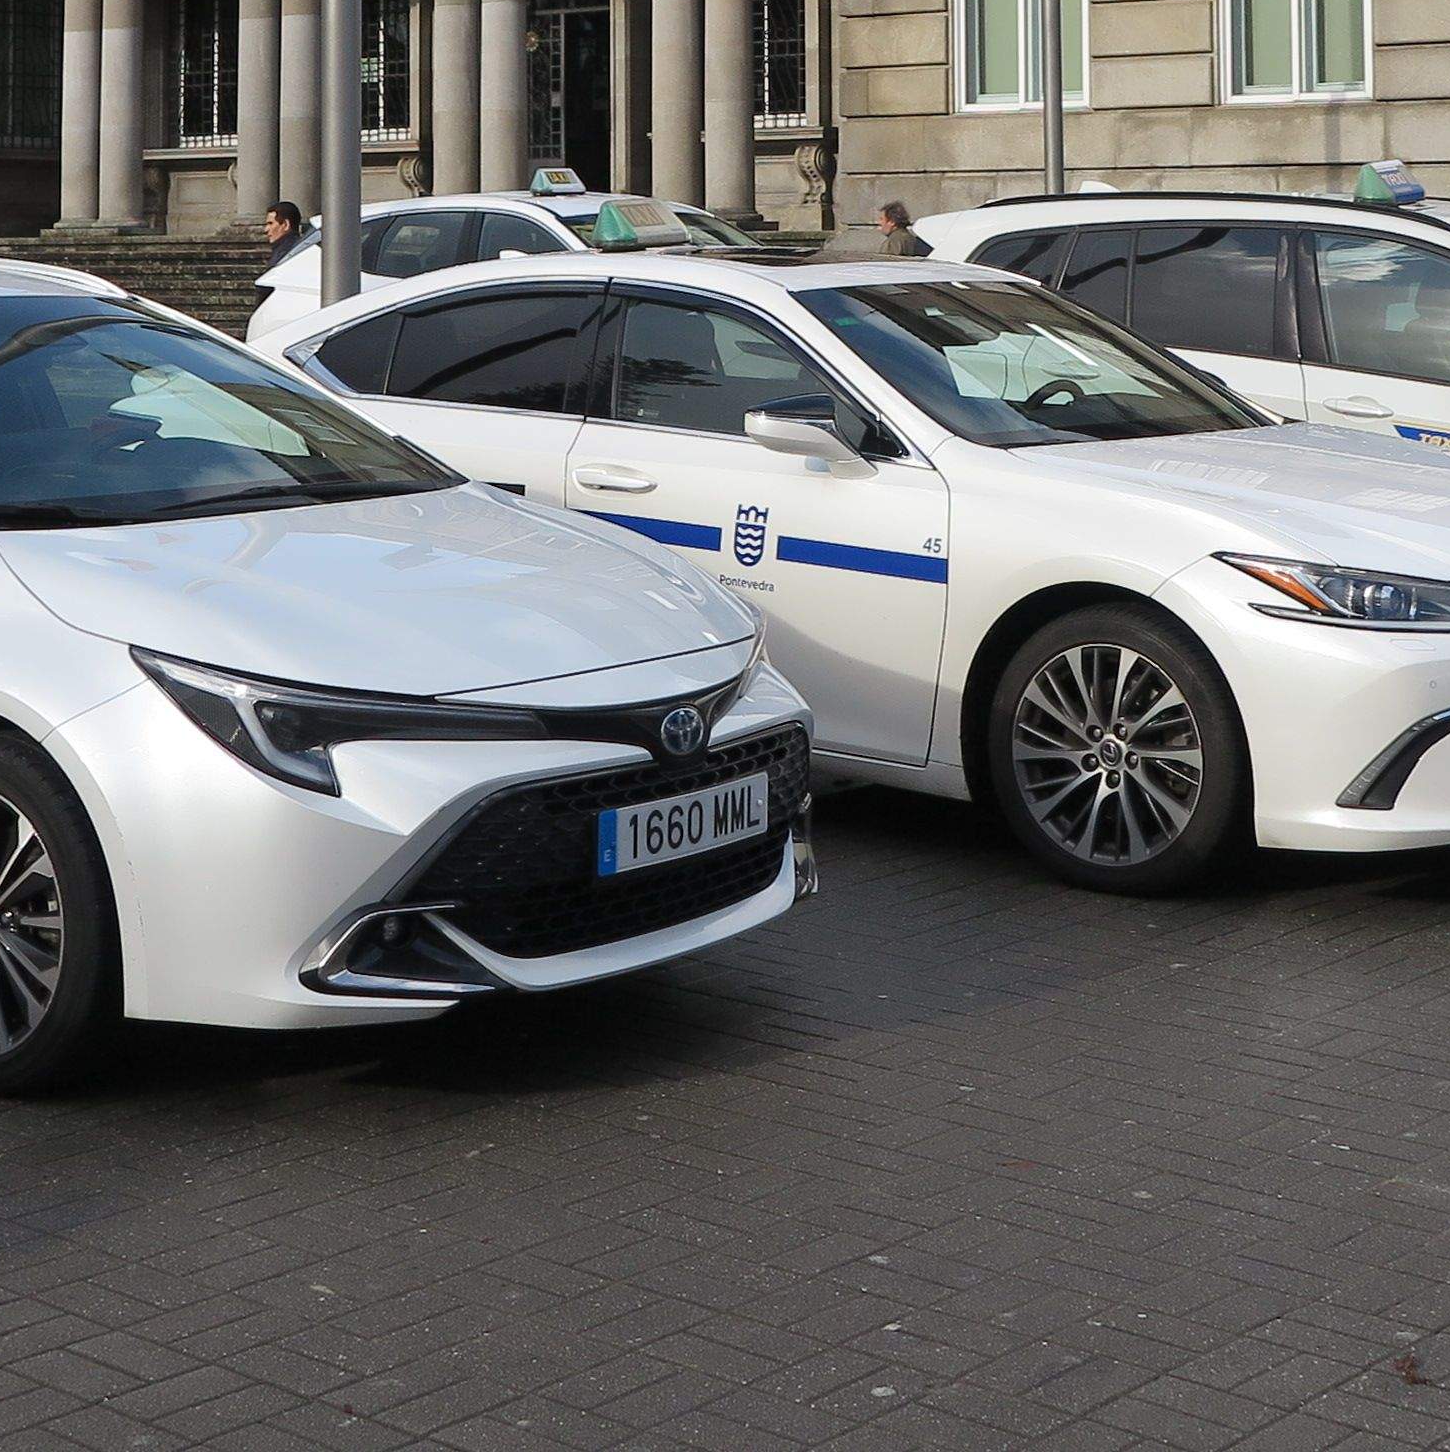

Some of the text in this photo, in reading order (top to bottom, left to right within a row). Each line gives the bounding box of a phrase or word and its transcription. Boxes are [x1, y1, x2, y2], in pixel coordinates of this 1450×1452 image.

[620, 204, 664, 227] TAXI
[922, 537, 943, 554] 45
[718, 574, 776, 593] Pontevedra
[628, 784, 761, 860] 1660 MML
[603, 848, 612, 863] E
